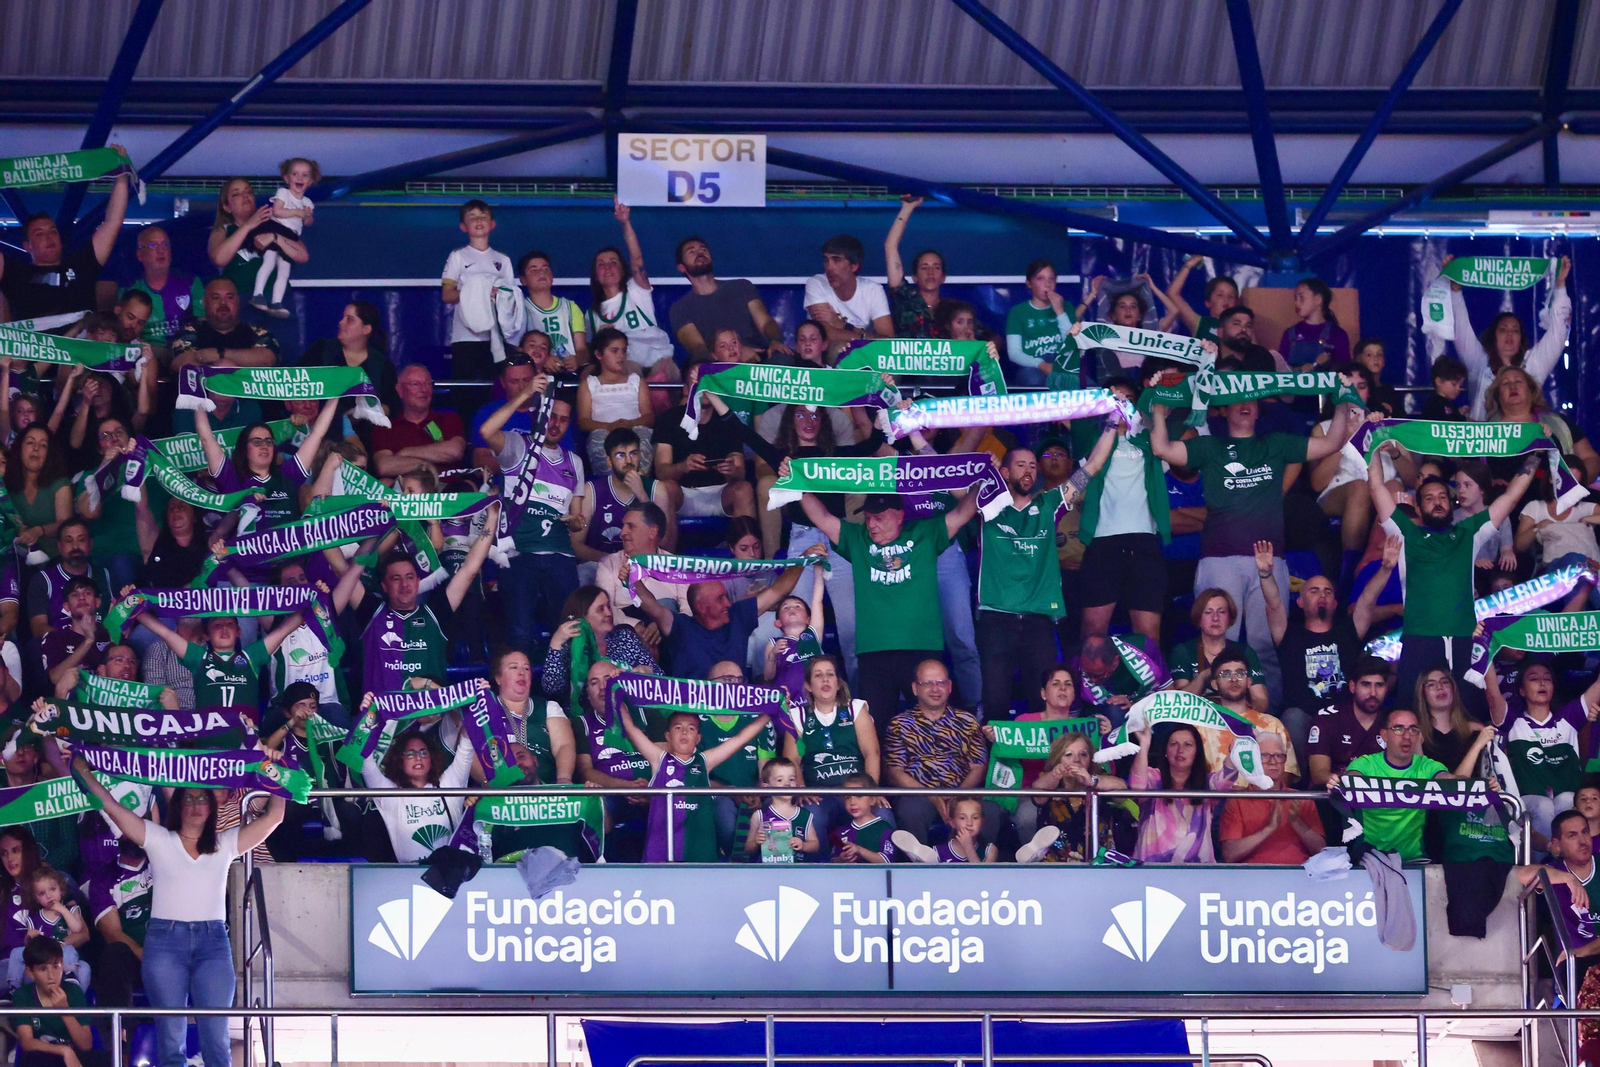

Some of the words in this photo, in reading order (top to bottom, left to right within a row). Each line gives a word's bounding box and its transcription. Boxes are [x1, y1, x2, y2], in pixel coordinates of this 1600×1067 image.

[629, 138, 755, 162] SECTOR
[14, 154, 69, 171] UNICAJA
[3, 165, 83, 185] BALONCESTO
[667, 170, 721, 204] D5
[1474, 258, 1531, 273] UNICAJA
[542, 316, 560, 333] 15
[625, 310, 640, 330] 8
[0, 341, 71, 361] ALONCESTO
[891, 340, 952, 356] UNICAJA
[1128, 331, 1203, 362] Unicaja
[877, 355, 965, 372] BALONCESTO
[251, 369, 310, 383] UNICAJA
[750, 366, 811, 386] UNICAJA
[242, 381, 323, 396] BALONCESTO
[735, 379, 824, 402] BALONCESTO
[937, 394, 1027, 416] INFIERNO
[1032, 389, 1096, 409] VERDE
[1431, 424, 1521, 438] BALONCESTO
[1446, 439, 1507, 453] UNICAJA
[341, 466, 385, 496] NICAJA
[803, 462, 873, 485] Unicaja
[878, 460, 986, 481] Baloncesto
[391, 501, 442, 517] UNICAJ
[236, 524, 301, 557] UNICAJA
[303, 508, 389, 549] BALONCESTO
[541, 519, 553, 537] 9
[647, 554, 732, 575] INFIERNO
[158, 587, 250, 614] BALONCESTO
[256, 586, 318, 611] UNICAJA
[1490, 574, 1555, 608] VERDE
[1536, 615, 1598, 632] UNICAJA
[401, 639, 427, 649] Unicaja
[385, 660, 422, 672] málaga
[88, 675, 149, 698] UNICAJA
[223, 674, 247, 683] Unicaja
[220, 686, 235, 708] 17
[618, 679, 682, 705] UNICAJA
[688, 681, 780, 709] BALONCESTO
[67, 706, 229, 736] UNICAJA
[79, 748, 142, 779] NICAJA
[148, 752, 245, 784] BALONCESTO
[610, 760, 650, 773] málaga
[491, 801, 581, 822] BALONCESTO
[467, 889, 676, 925] Fundación
[833, 890, 1043, 926] Fundación
[1200, 891, 1377, 927] Fundació
[467, 927, 617, 973] Unicaja
[833, 928, 984, 973] Unicaja
[1200, 928, 1349, 974] Unicaja
